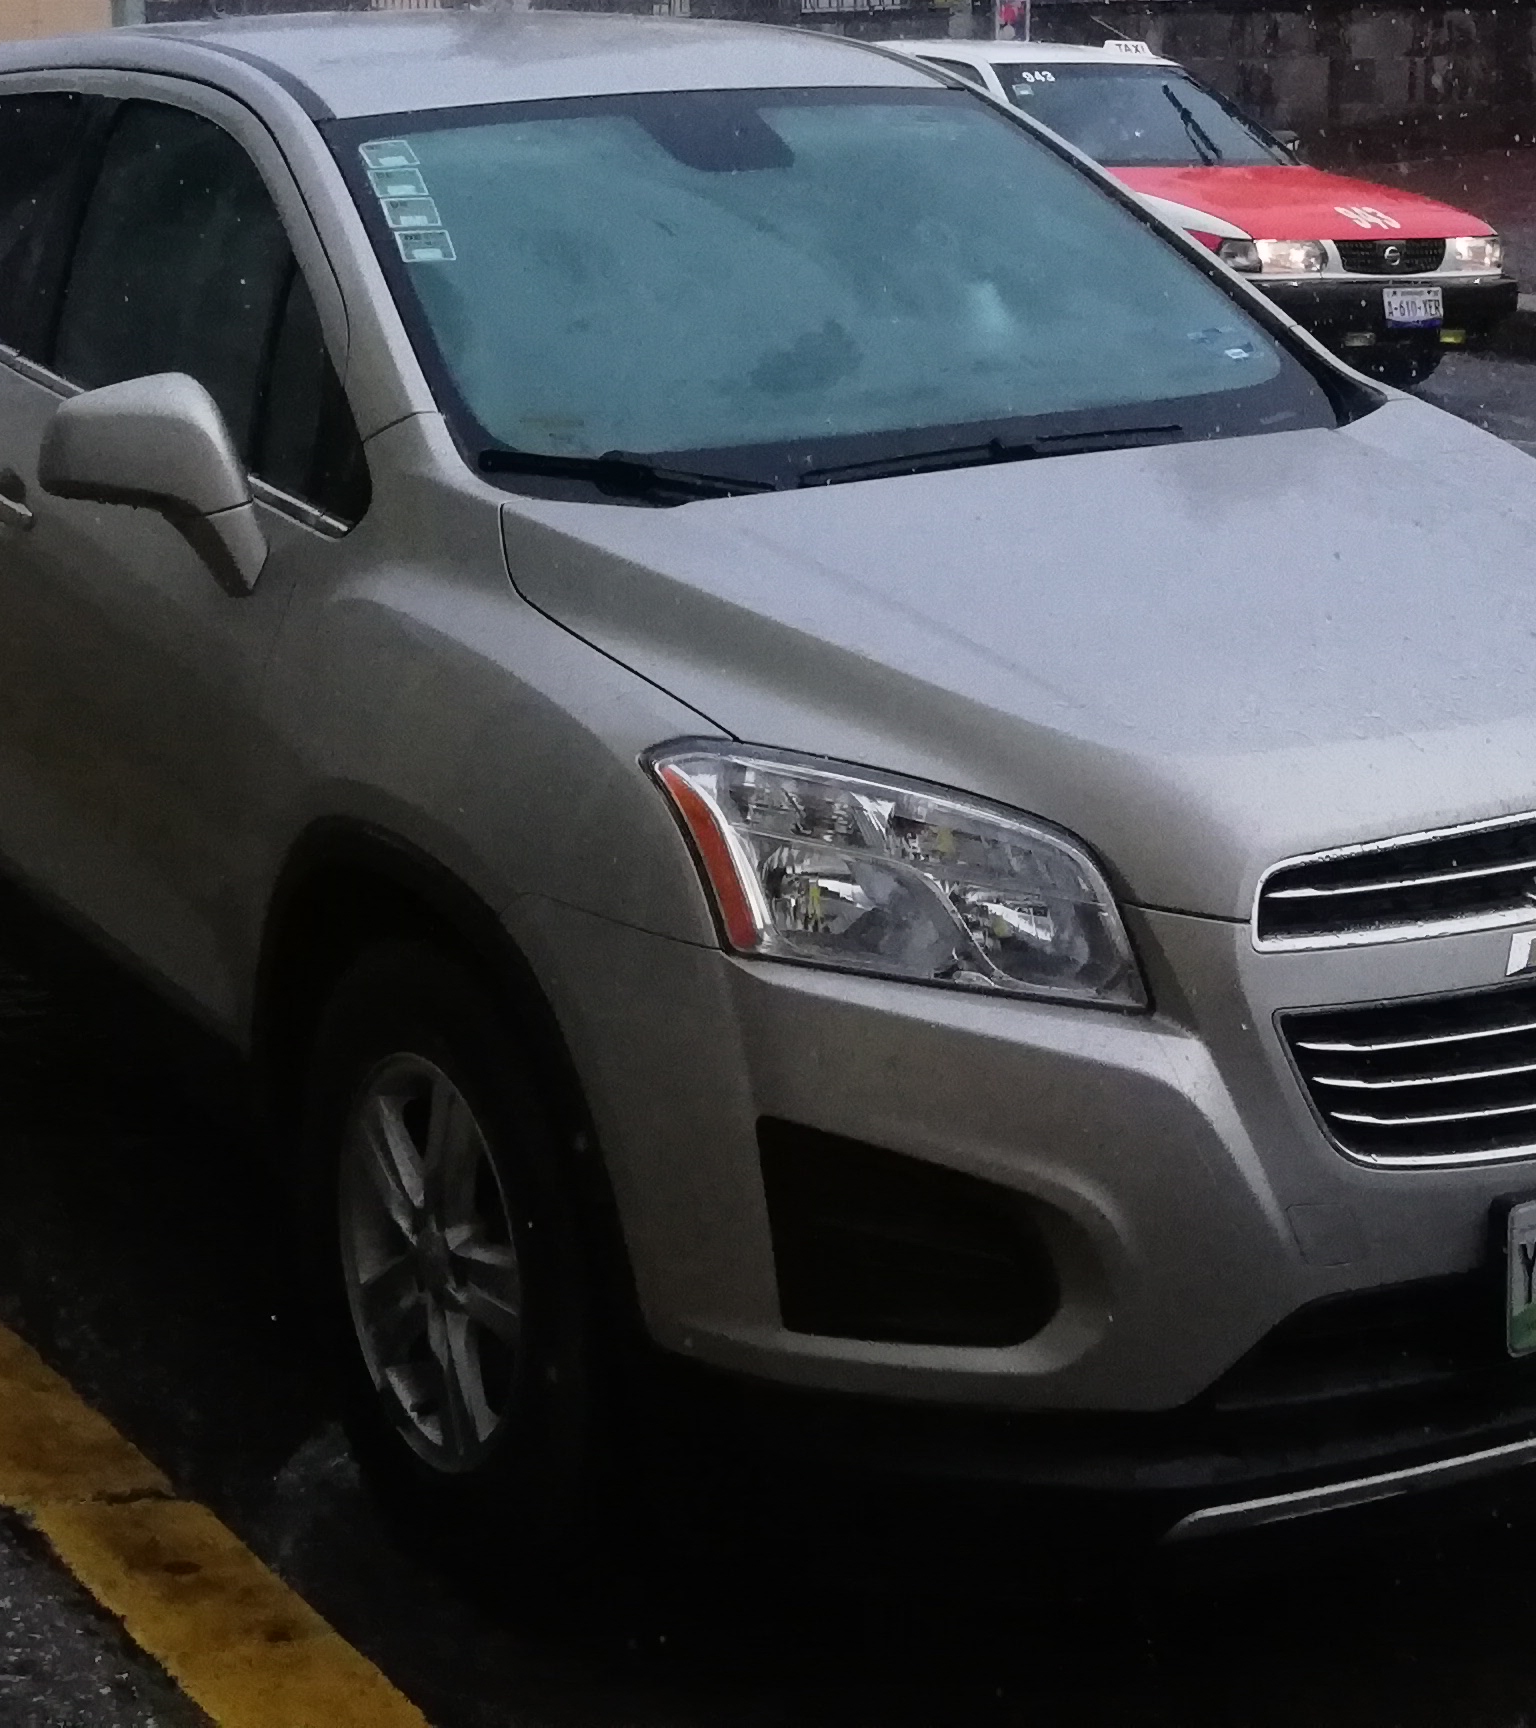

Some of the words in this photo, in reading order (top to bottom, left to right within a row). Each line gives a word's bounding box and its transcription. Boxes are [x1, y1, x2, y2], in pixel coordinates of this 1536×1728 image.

[1115, 43, 1146, 54] TAXI
[1022, 71, 1056, 82] 943
[1333, 206, 1401, 230] 943
